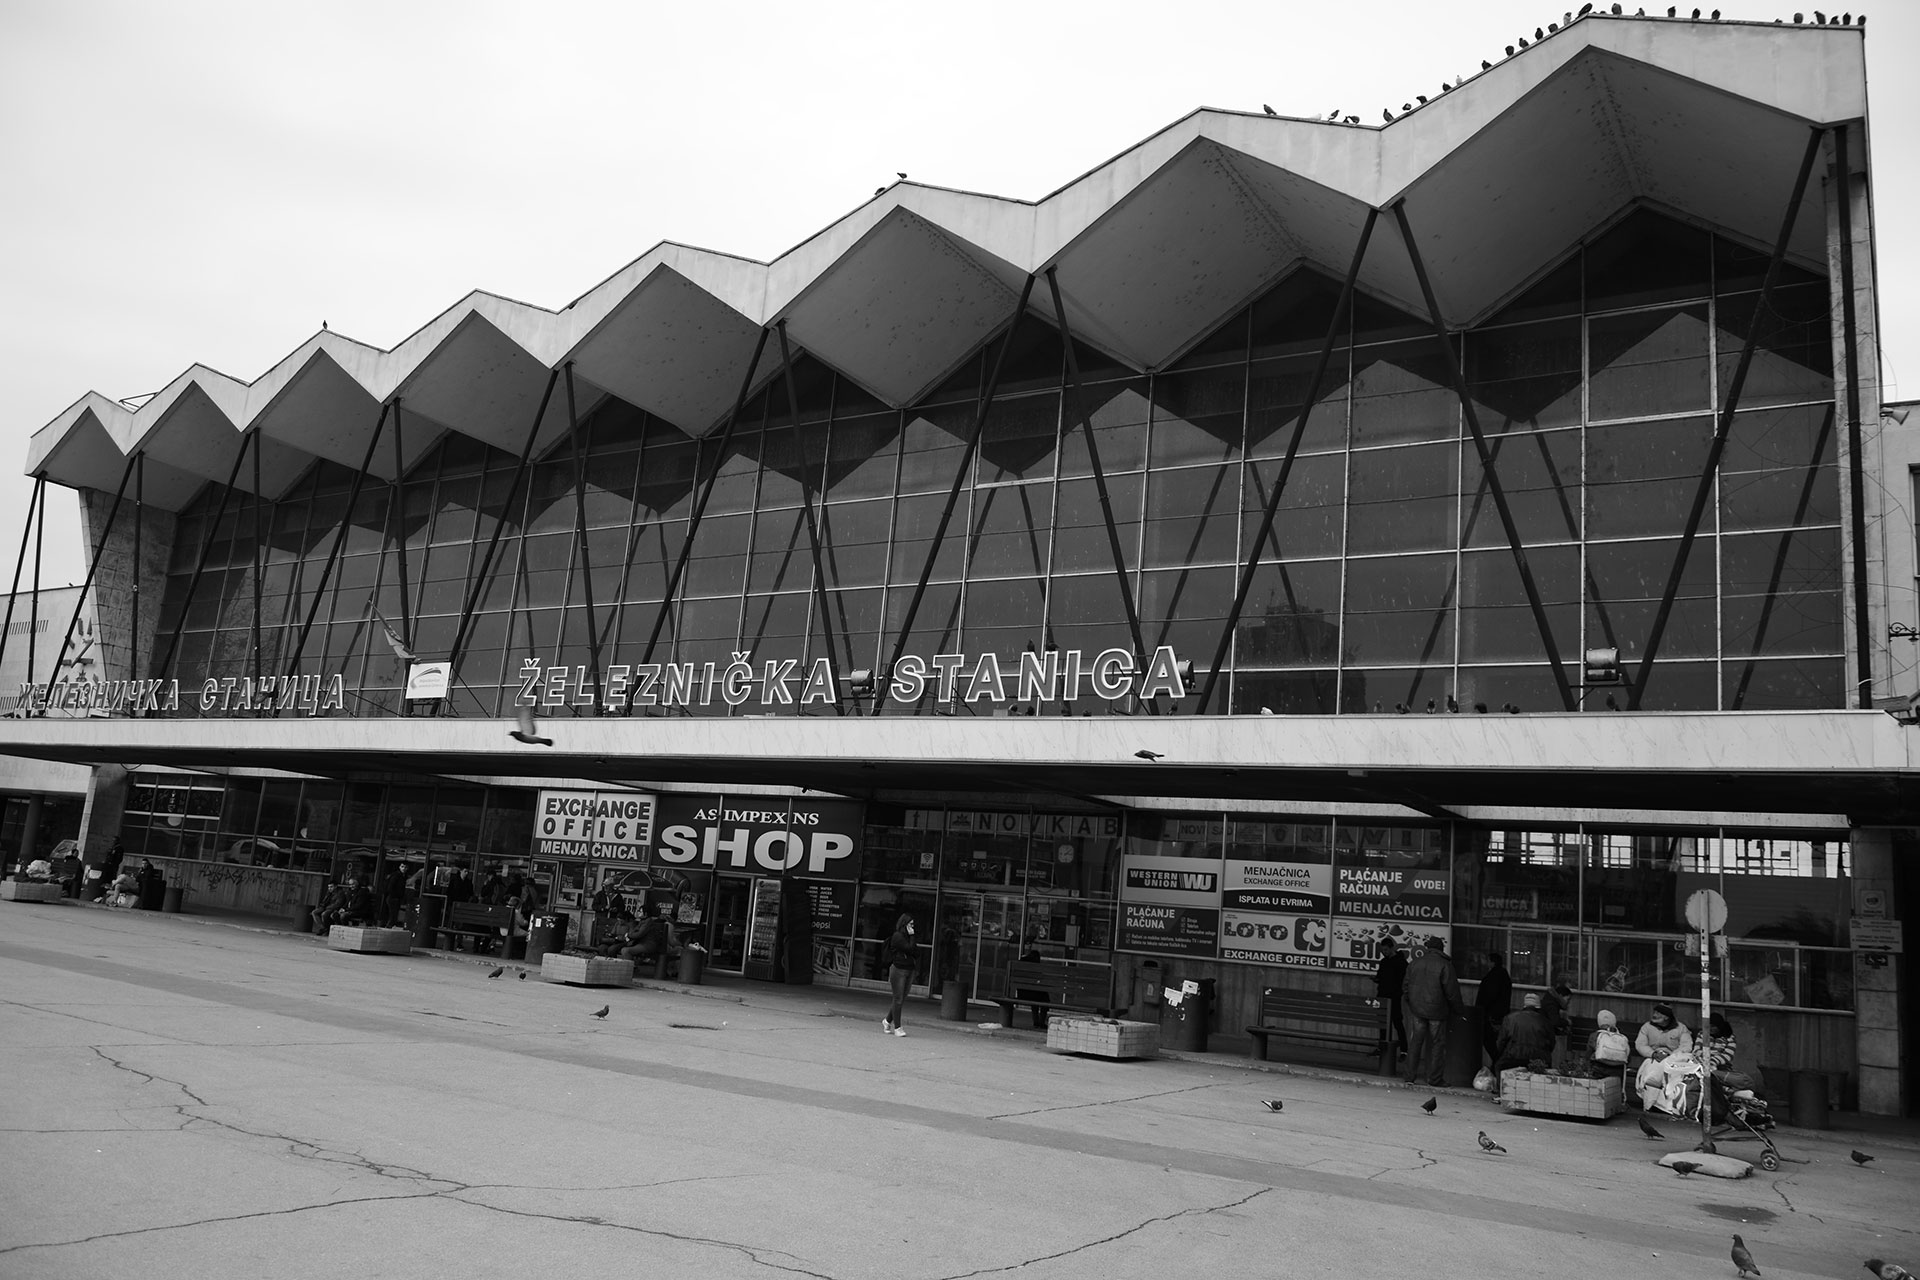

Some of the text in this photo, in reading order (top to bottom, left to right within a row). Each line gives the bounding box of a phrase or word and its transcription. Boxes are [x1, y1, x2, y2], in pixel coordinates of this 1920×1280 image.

[515, 645, 1186, 706] ŽELEZNIČKA STANICA
[15, 673, 344, 716] ЖЕЛЕЗНИЧКА СТАНИЦА
[545, 797, 651, 820] EXCHANGE
[693, 807, 820, 826] AS IMPEX NS
[542, 820, 648, 841] OFFICE
[540, 839, 638, 860] MENJAČNICA
[658, 825, 854, 873] SHOP
[1130, 870, 1213, 891] WESTERN WU
[1243, 865, 1311, 879] MENJAČNICA
[1340, 867, 1446, 890] PLAĆANJE OVDE!
[1144, 878, 1179, 888] UNION
[1243, 877, 1311, 888] EXCHANGE OFFICE
[1339, 880, 1390, 896] RAČUNA
[1238, 895, 1313, 908] ISPLATA U EVRIMA
[1339, 901, 1443, 919] MENJAČNICA
[1127, 905, 1175, 919] PLAĆANJE
[1126, 916, 1165, 930] RAČUNA
[1223, 921, 1289, 941] LOTO
[1224, 950, 1325, 967] EXCHANGE OFFICE
